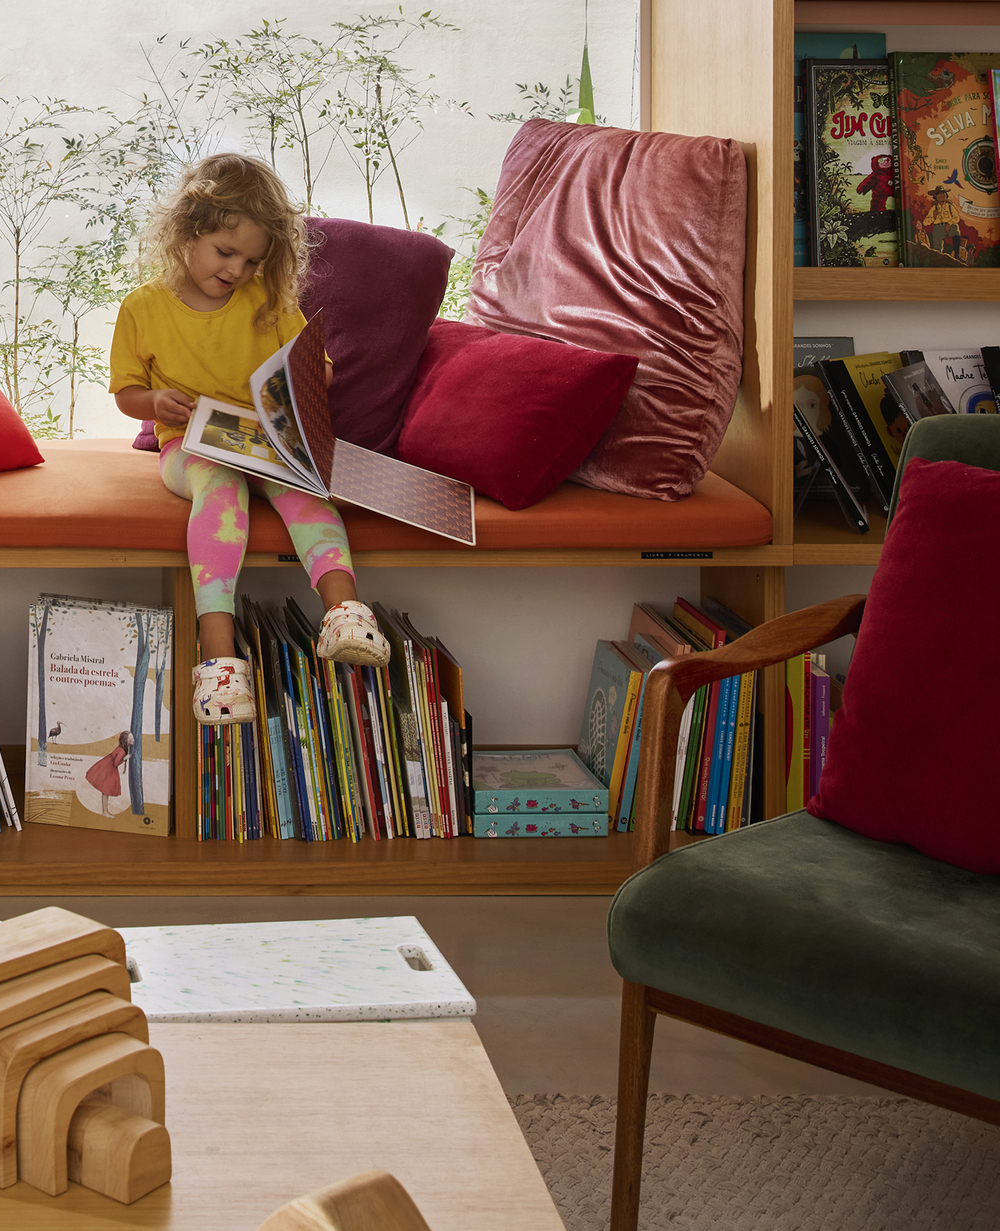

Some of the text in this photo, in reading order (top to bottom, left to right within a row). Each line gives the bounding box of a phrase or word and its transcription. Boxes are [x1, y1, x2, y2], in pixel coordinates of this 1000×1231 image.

[830, 110, 868, 139] JIM
[926, 110, 975, 146] SELVA
[946, 365, 975, 382] Madre
[852, 412, 872, 447] GRANDES SONHOS
[802, 426, 825, 461] GRANDES SONHOS
[50, 652, 105, 664] Gabriela Mistral
[50, 663, 118, 678] Balada da estrela
[56, 676, 83, 685] outros
[84, 678, 116, 688] poemas
